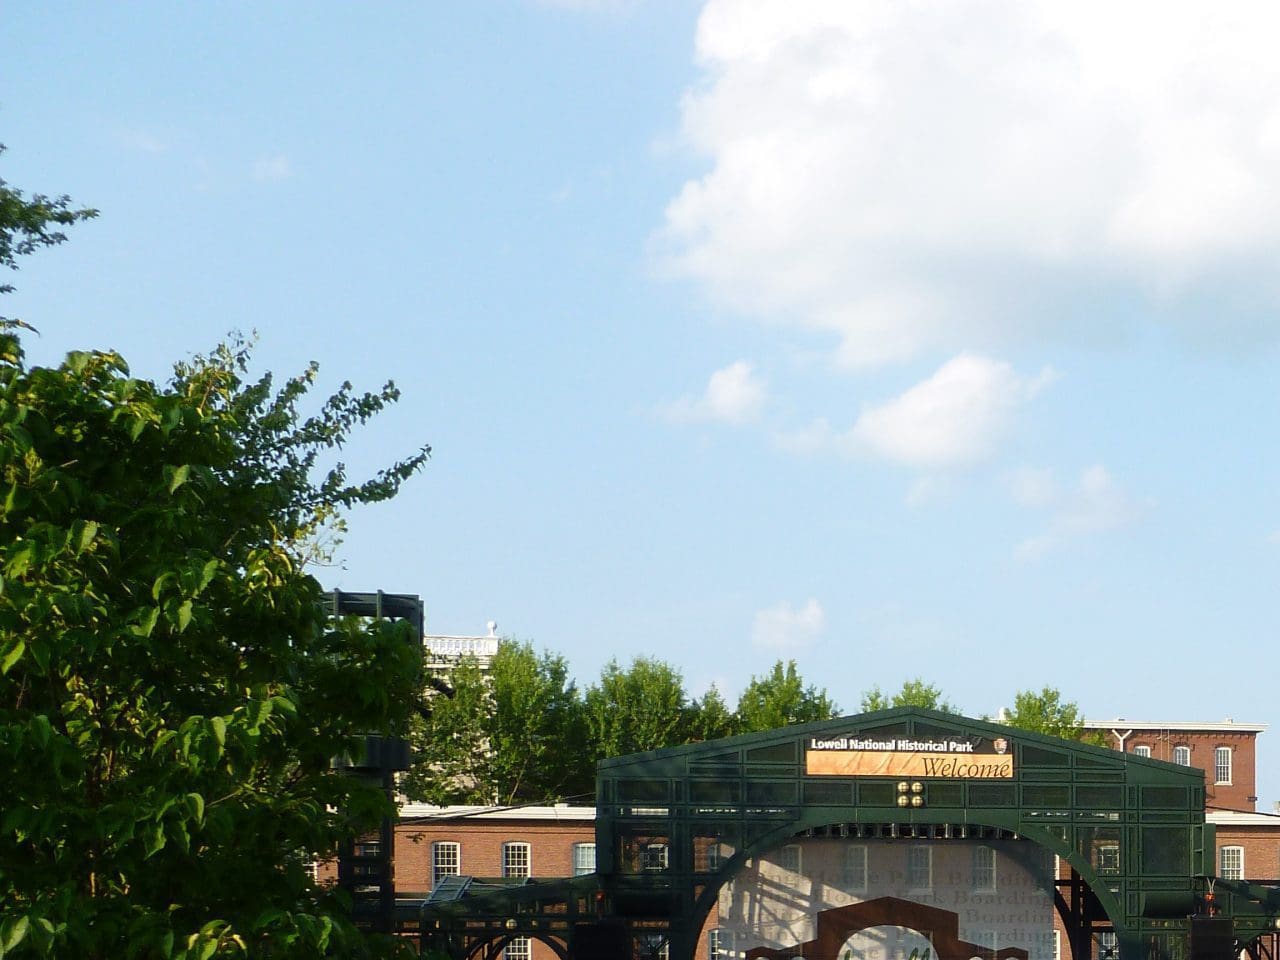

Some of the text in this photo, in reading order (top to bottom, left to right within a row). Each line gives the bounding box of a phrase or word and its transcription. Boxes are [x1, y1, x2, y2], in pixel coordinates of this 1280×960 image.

[811, 738, 973, 752] Lowell National Historical Park
[922, 757, 1010, 777] Welcome
